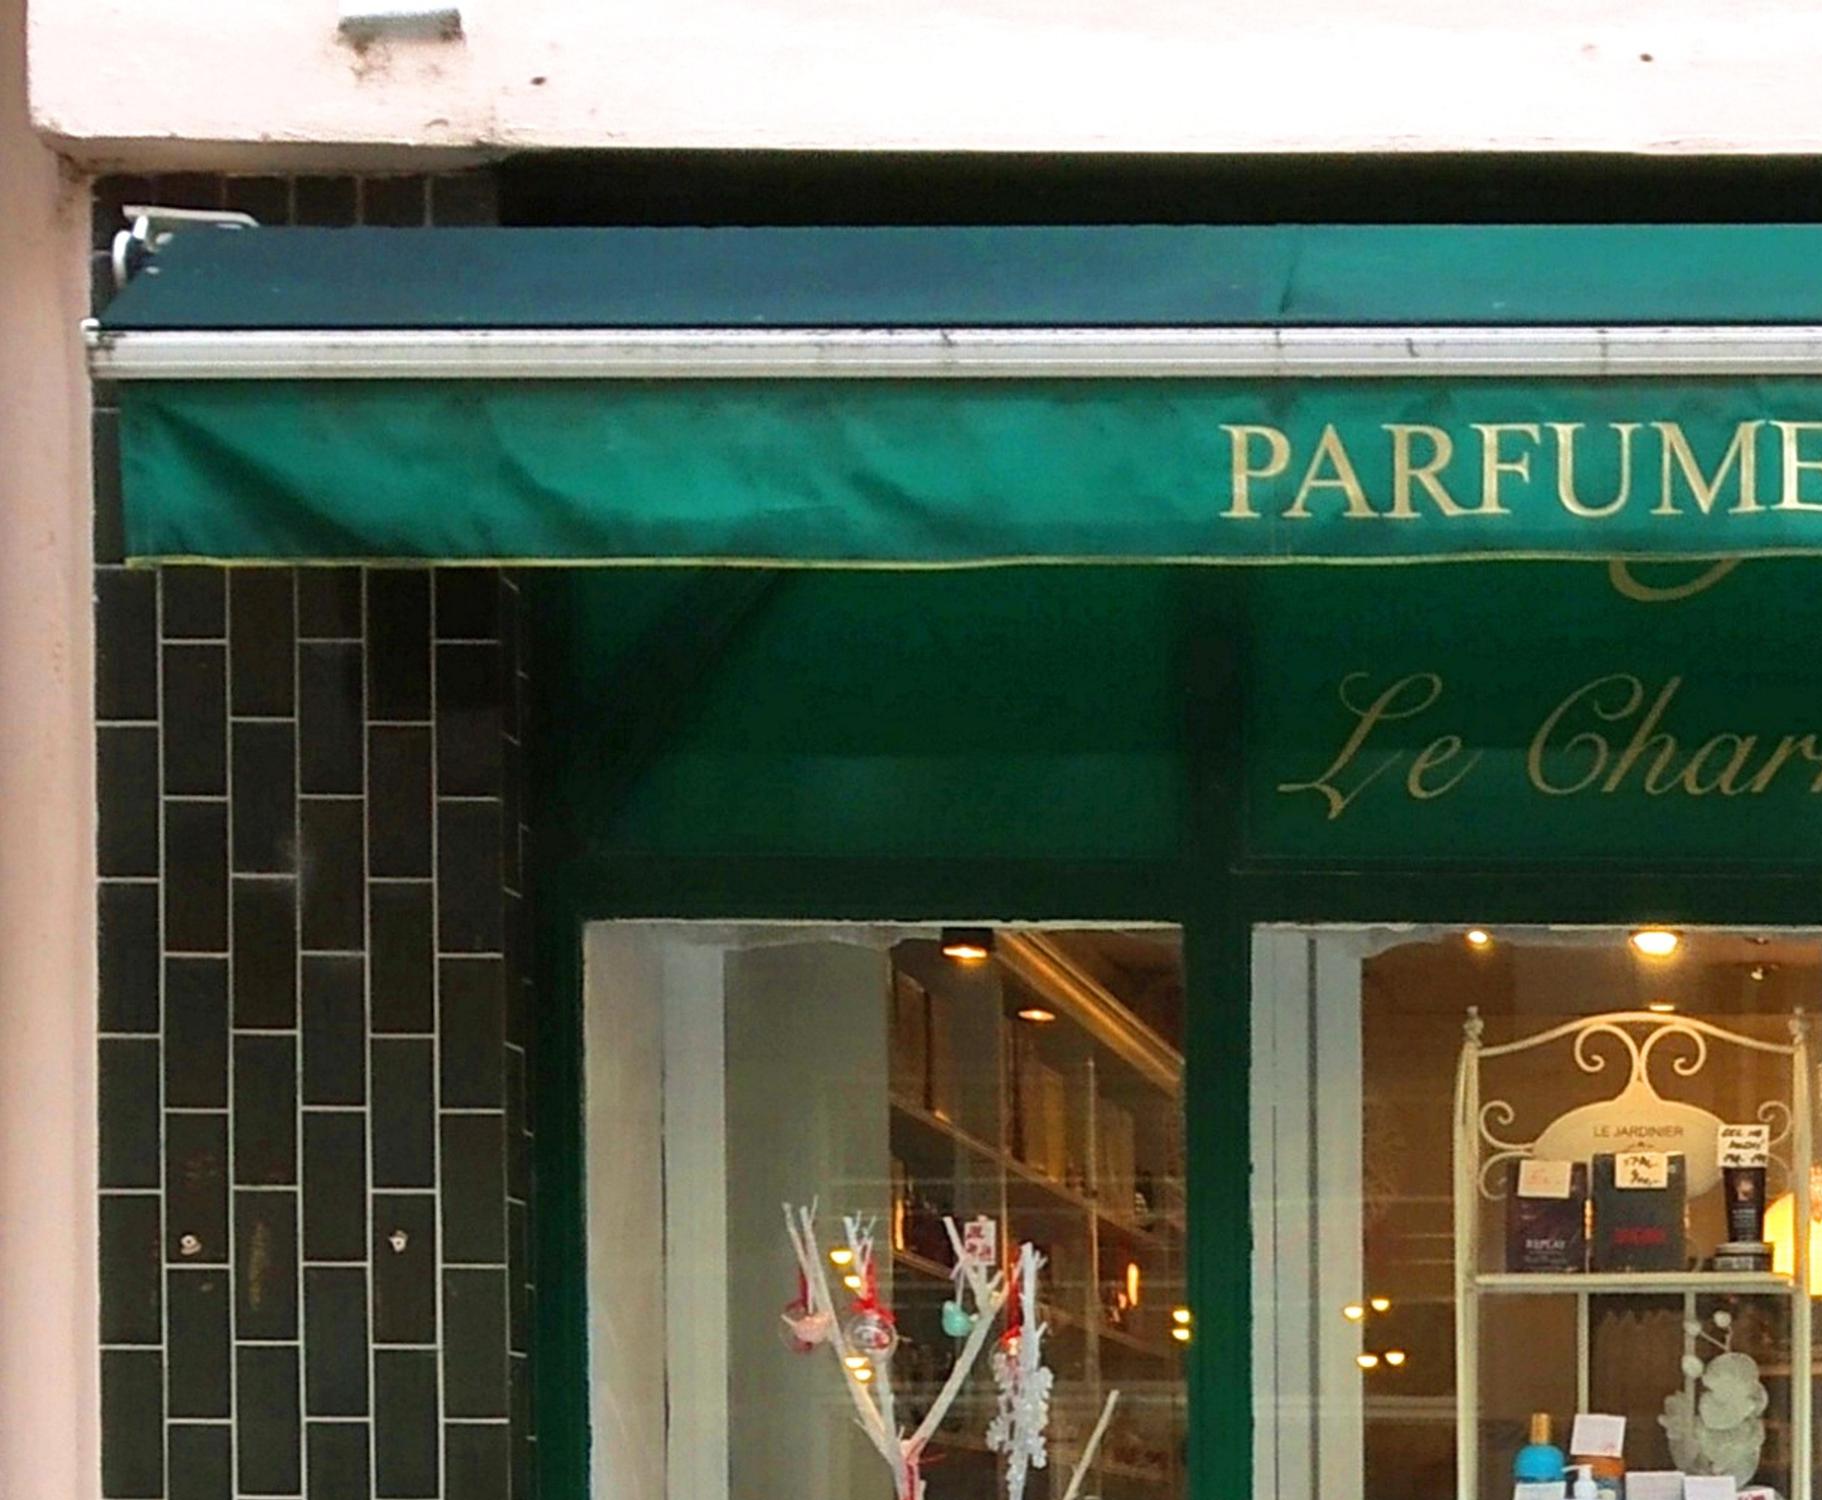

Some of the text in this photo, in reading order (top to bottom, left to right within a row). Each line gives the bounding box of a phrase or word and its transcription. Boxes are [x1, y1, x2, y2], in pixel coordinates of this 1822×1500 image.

[1277, 670, 1482, 820] Le
[1593, 1126, 1684, 1138] LE JARDINIER
